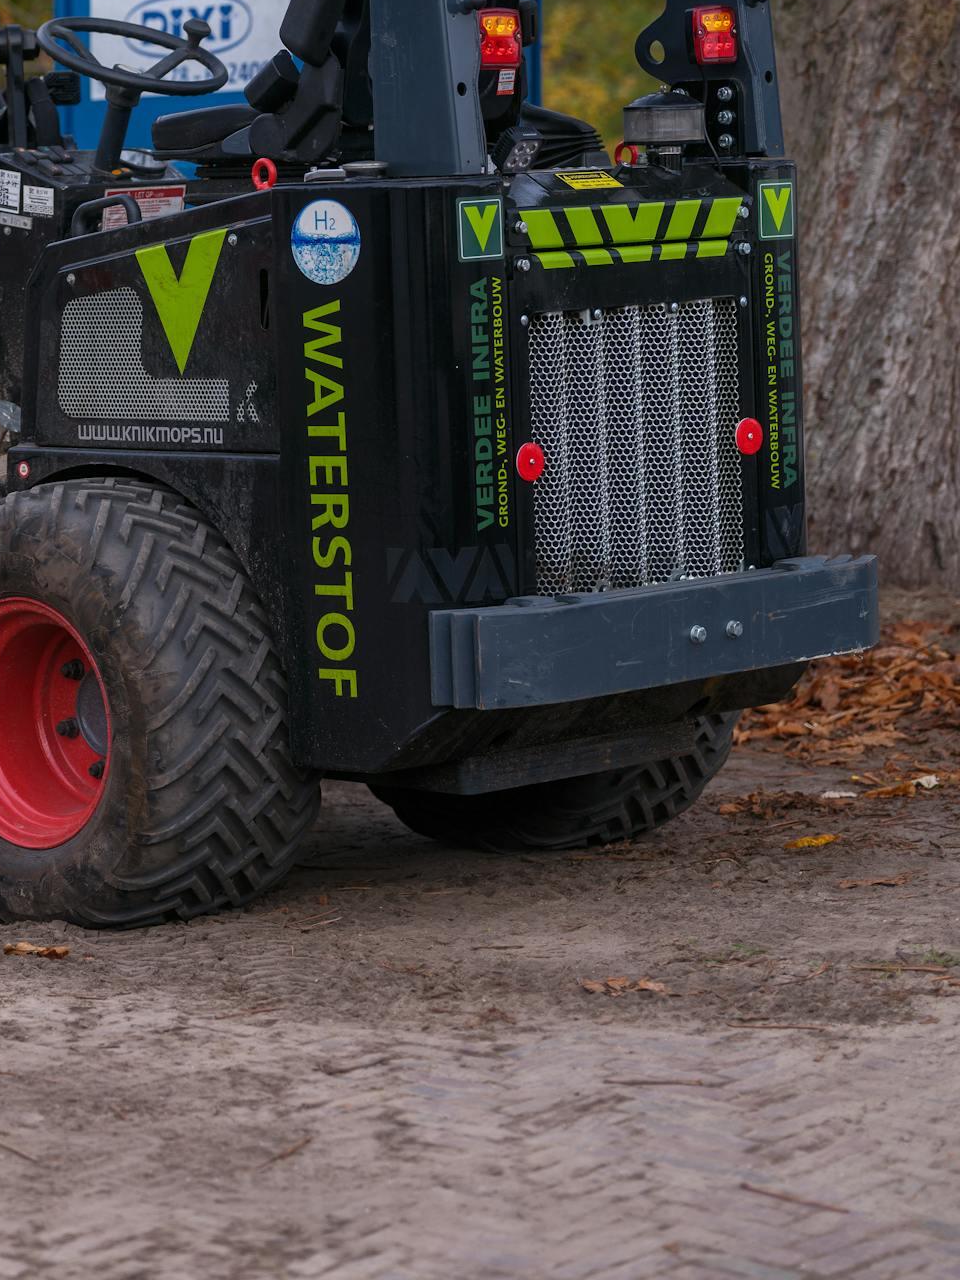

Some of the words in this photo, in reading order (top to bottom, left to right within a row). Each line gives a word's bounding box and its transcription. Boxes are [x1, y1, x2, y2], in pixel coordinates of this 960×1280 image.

[470, 276, 490, 381] INFRA
[492, 276, 505, 383] WATERBOUW
[777, 249, 795, 378] VERDEE
[495, 387, 505, 409] EN
[767, 365, 777, 386] EN
[473, 394, 495, 532] VERDEE
[496, 412, 507, 456] WEG-
[768, 389, 780, 489] WATERBOUW
[780, 391, 798, 489] INFRA
[302, 299, 358, 699] WATERSTOF
